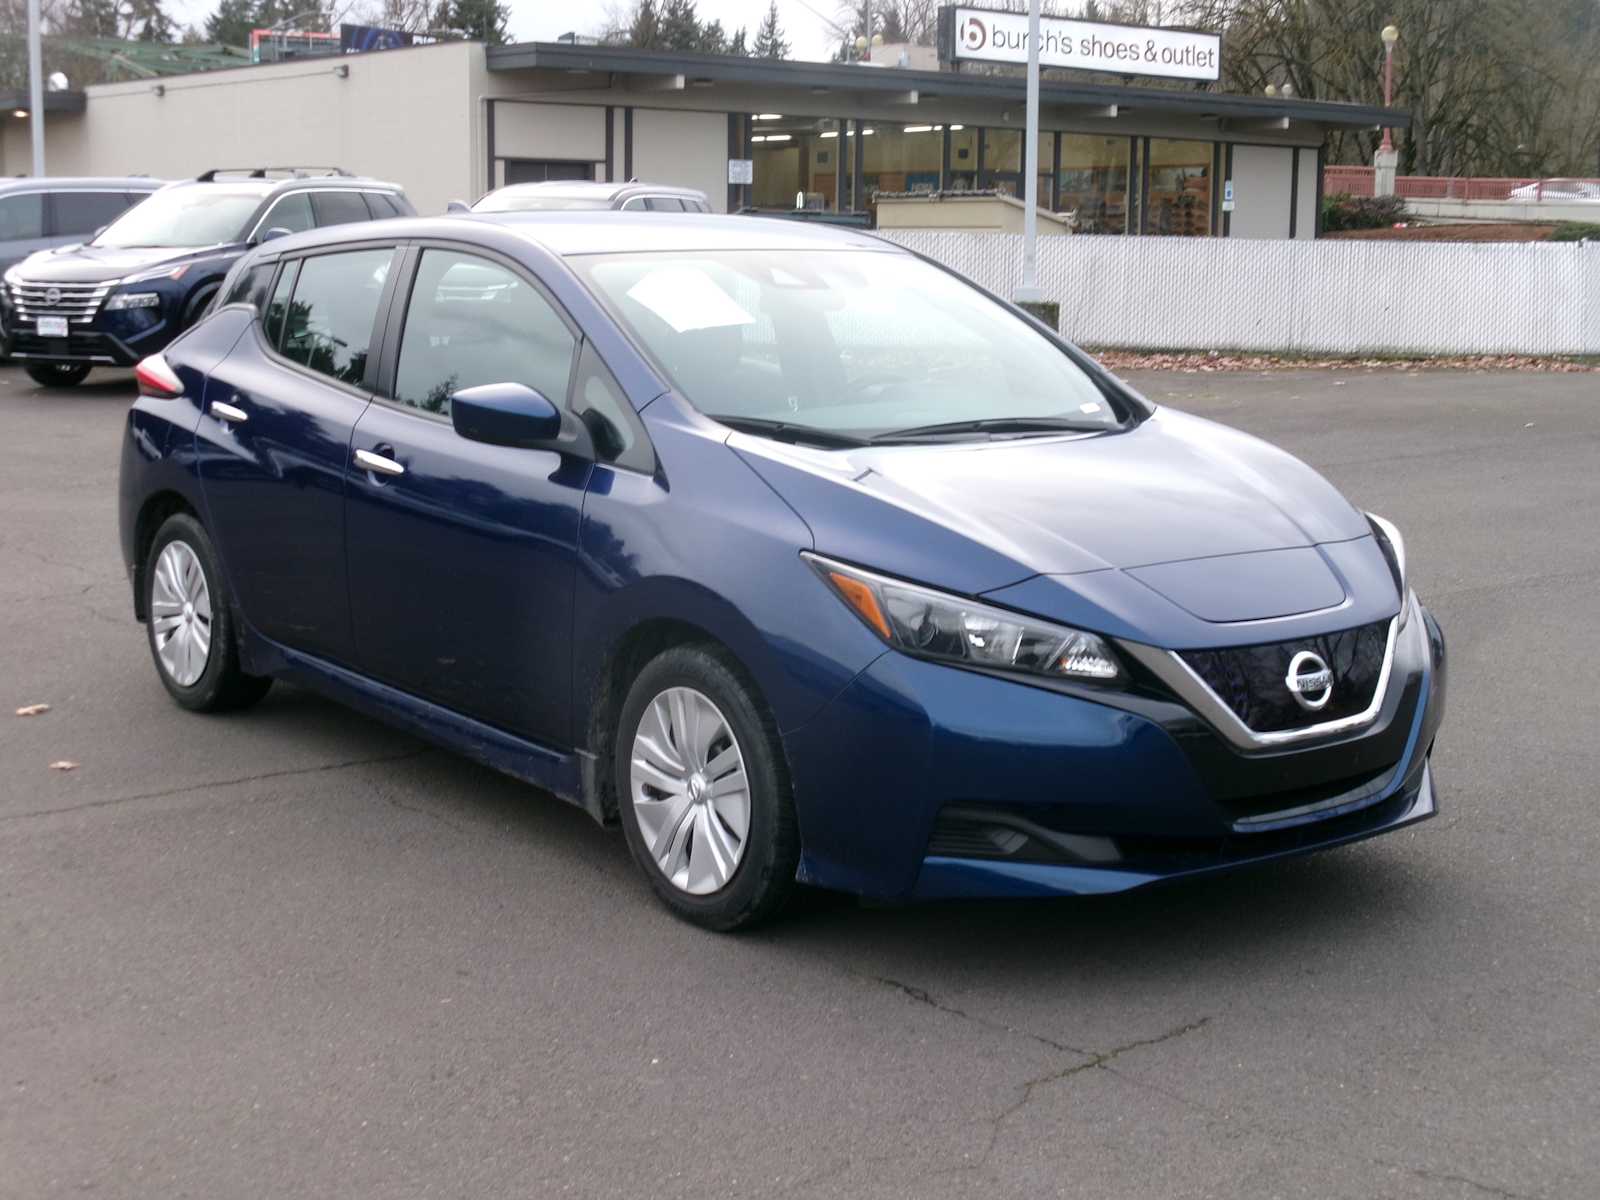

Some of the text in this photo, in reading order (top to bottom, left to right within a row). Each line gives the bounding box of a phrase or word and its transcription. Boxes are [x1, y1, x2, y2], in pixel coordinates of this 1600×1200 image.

[1080, 34, 1140, 61] shoes
[1144, 39, 1158, 63] &
[1161, 45, 1215, 69] outlet
